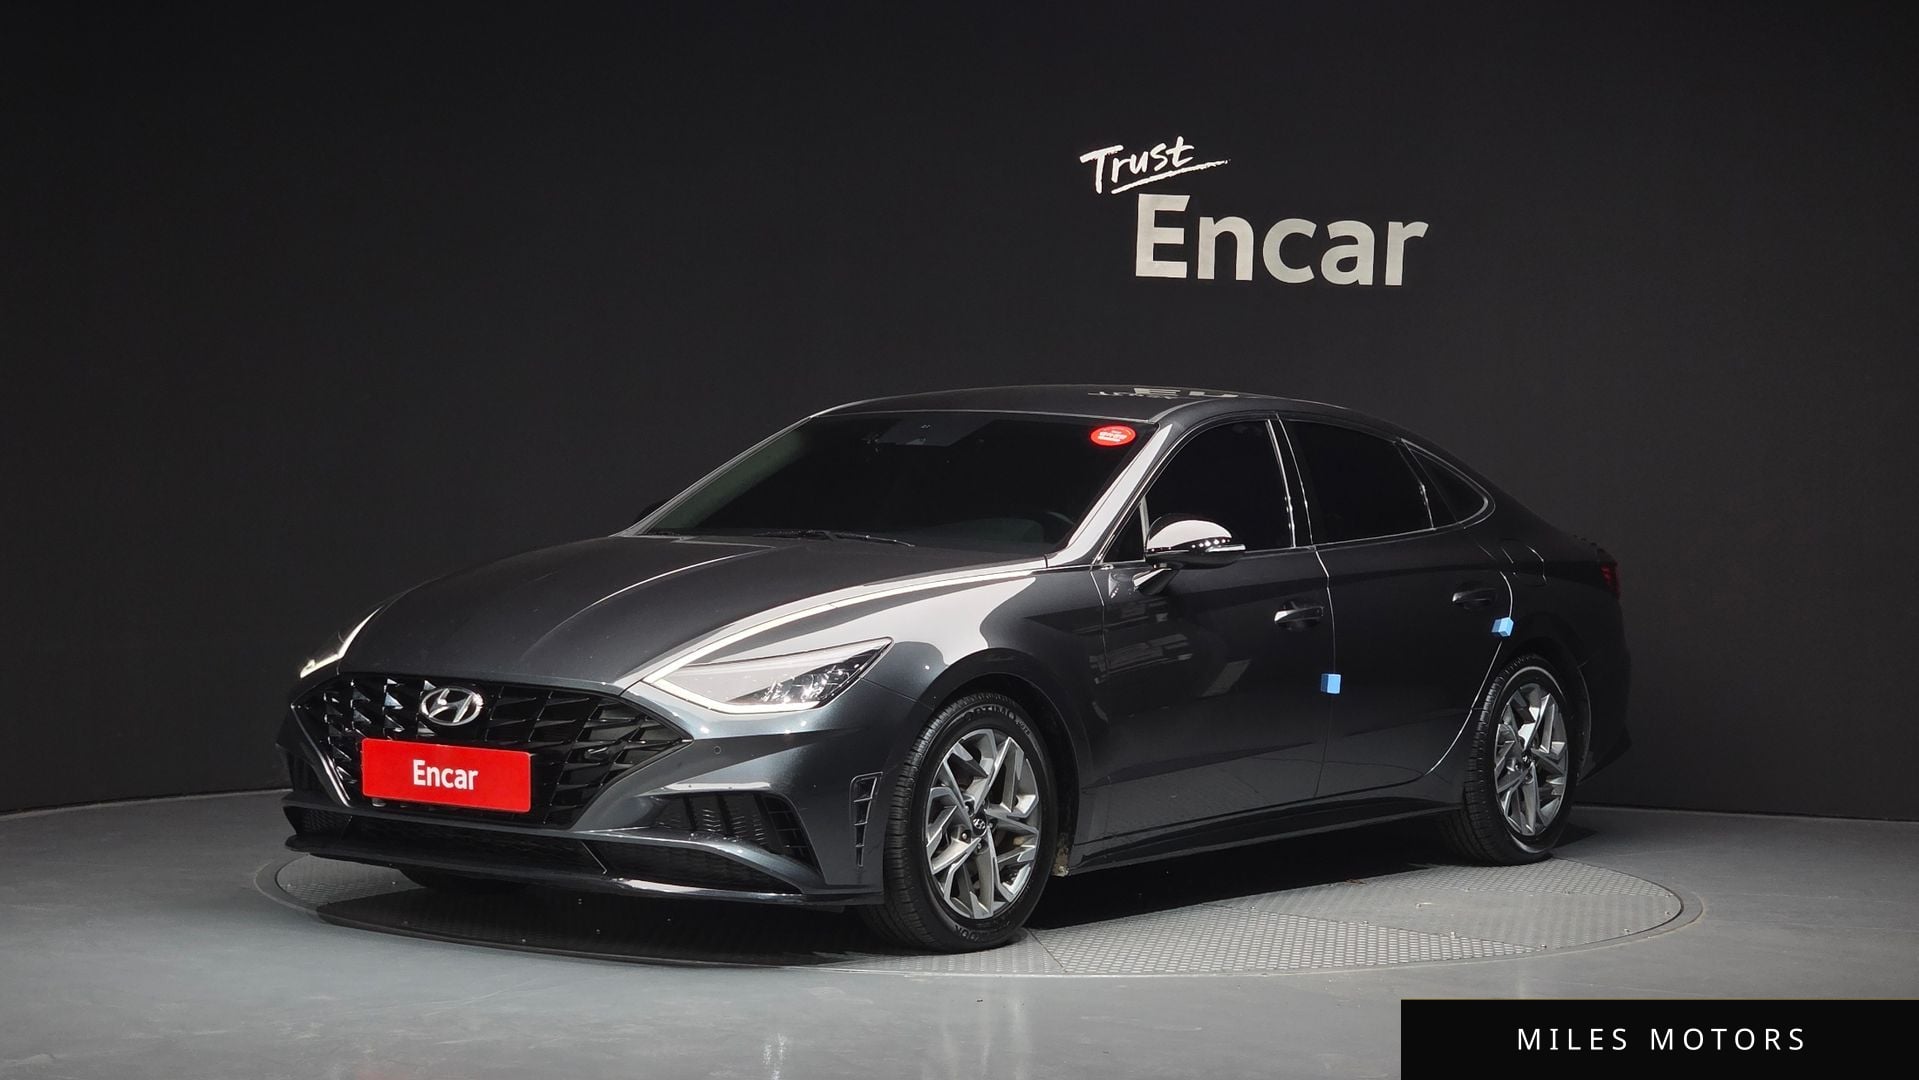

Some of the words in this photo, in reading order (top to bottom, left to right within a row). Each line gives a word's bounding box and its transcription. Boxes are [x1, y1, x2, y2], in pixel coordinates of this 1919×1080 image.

[1080, 136, 1195, 194] Trust
[1136, 193, 1429, 286] Encar
[413, 759, 479, 790] Encar
